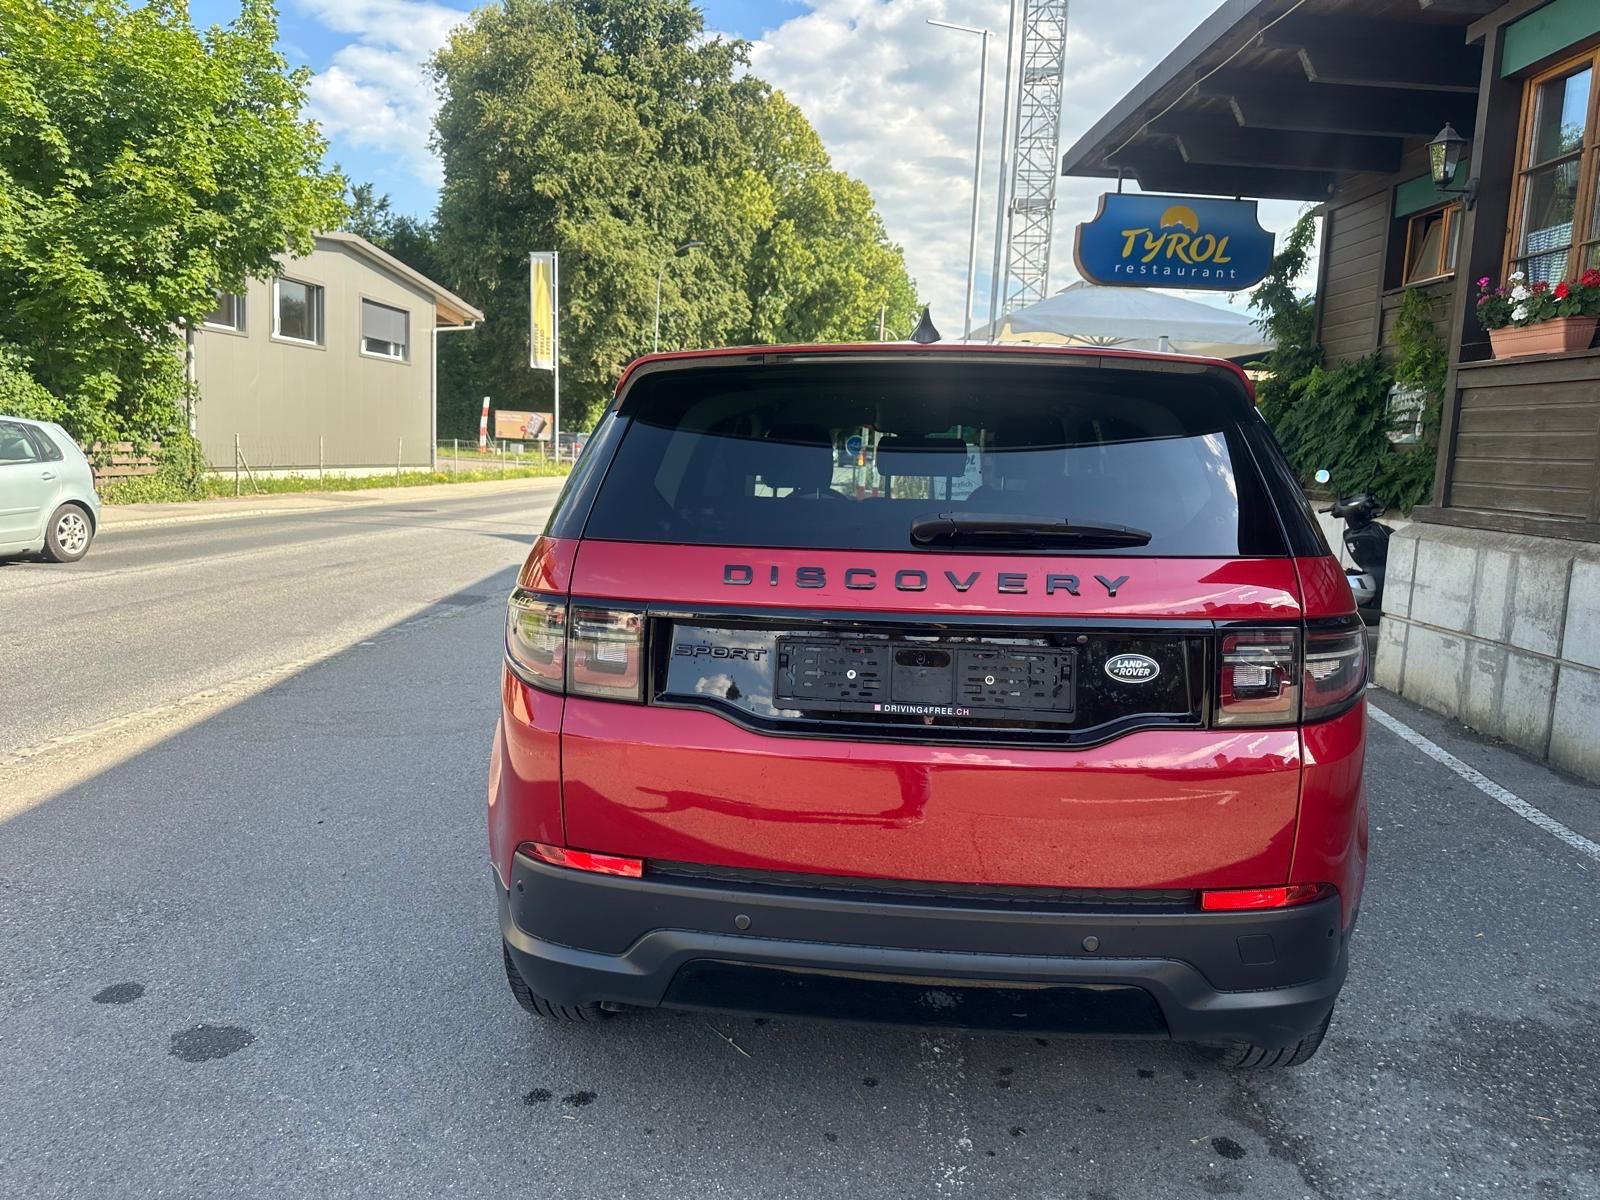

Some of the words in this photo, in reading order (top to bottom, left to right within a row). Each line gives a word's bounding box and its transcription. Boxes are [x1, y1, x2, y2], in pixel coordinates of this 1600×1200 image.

[1121, 227, 1232, 264] TYROL
[1114, 263, 1236, 279] restaurant
[722, 564, 1130, 597] DISCOVERY
[675, 644, 767, 661] SPORT
[1116, 660, 1143, 668] LAND
[1118, 667, 1151, 676] ROVER
[884, 704, 970, 716] DRIVING4FREE.CH
